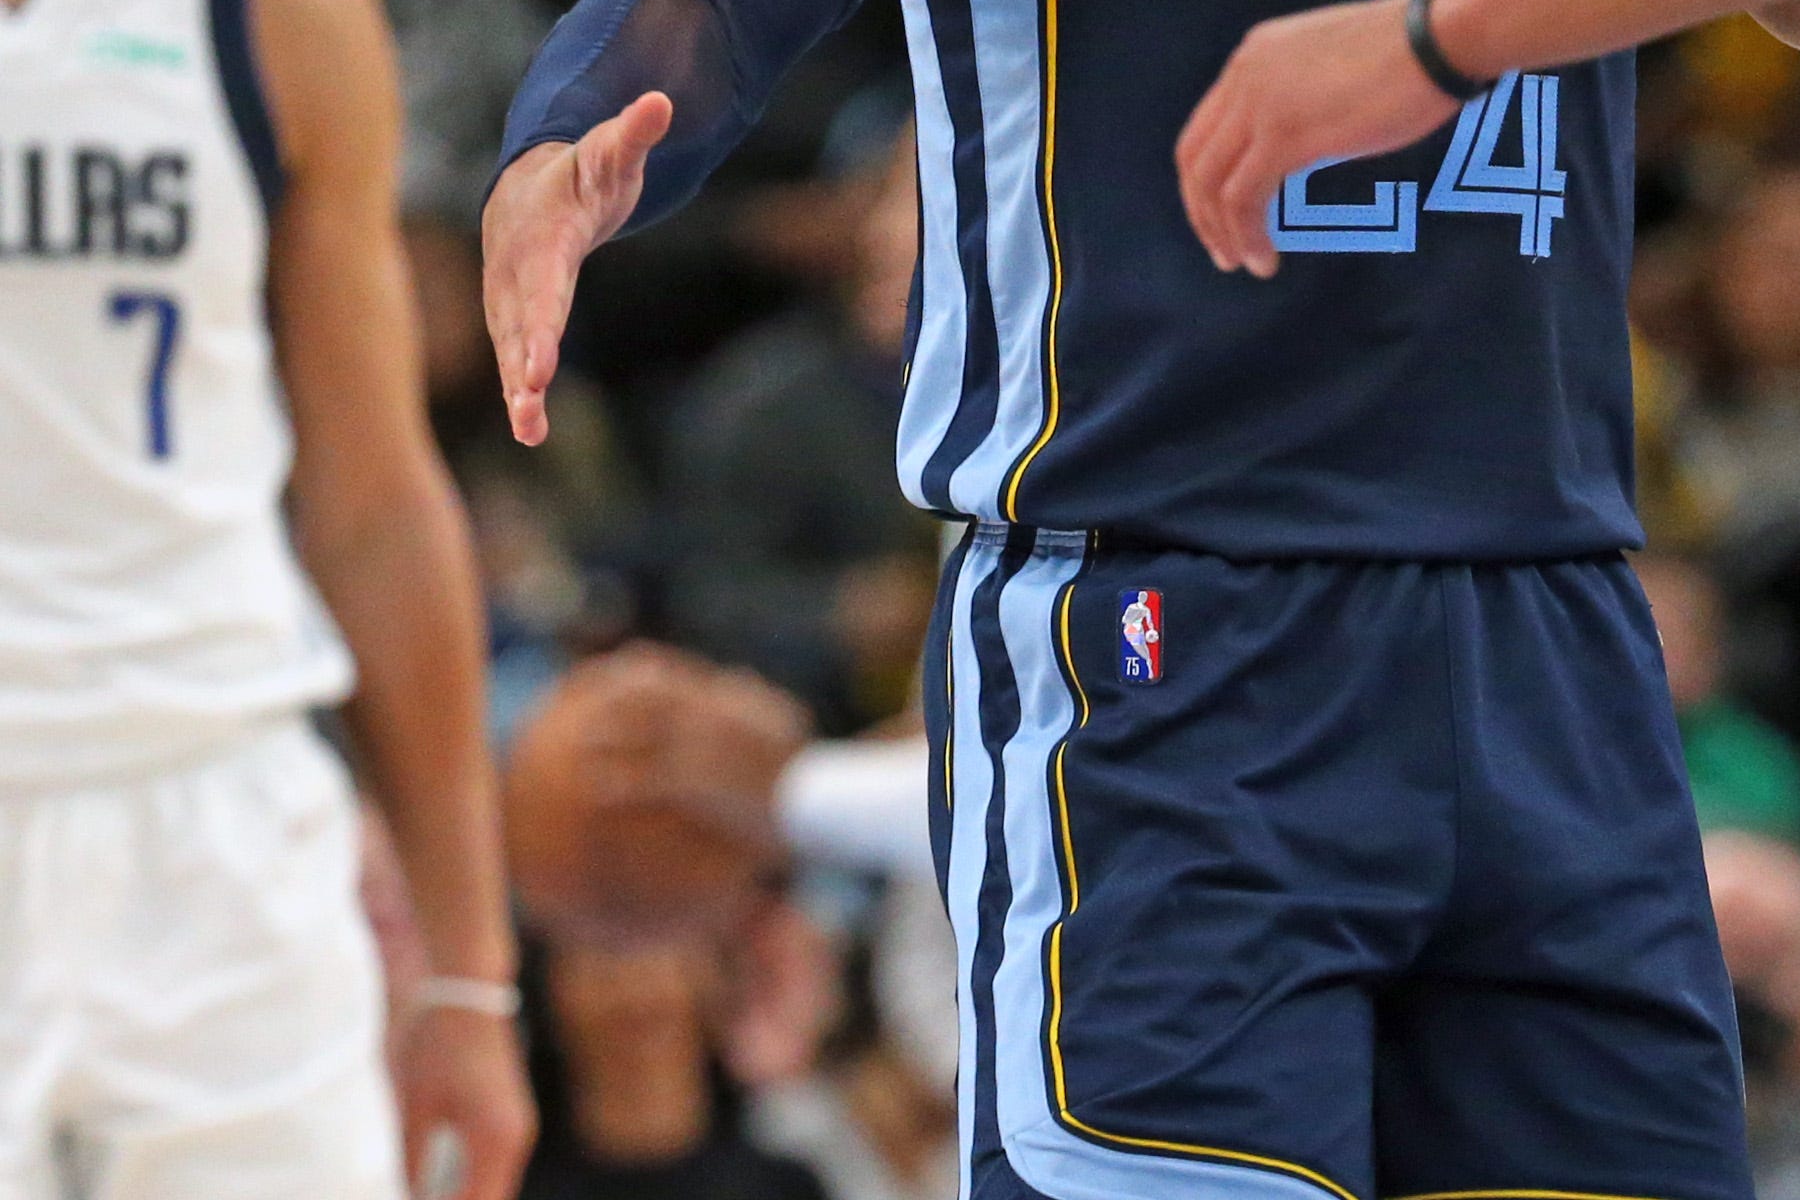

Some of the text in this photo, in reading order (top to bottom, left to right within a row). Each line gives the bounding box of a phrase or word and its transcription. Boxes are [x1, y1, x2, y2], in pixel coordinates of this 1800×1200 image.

[0, 146, 190, 257] LAS
[109, 292, 181, 458] 7
[1125, 657, 1140, 676] 75
